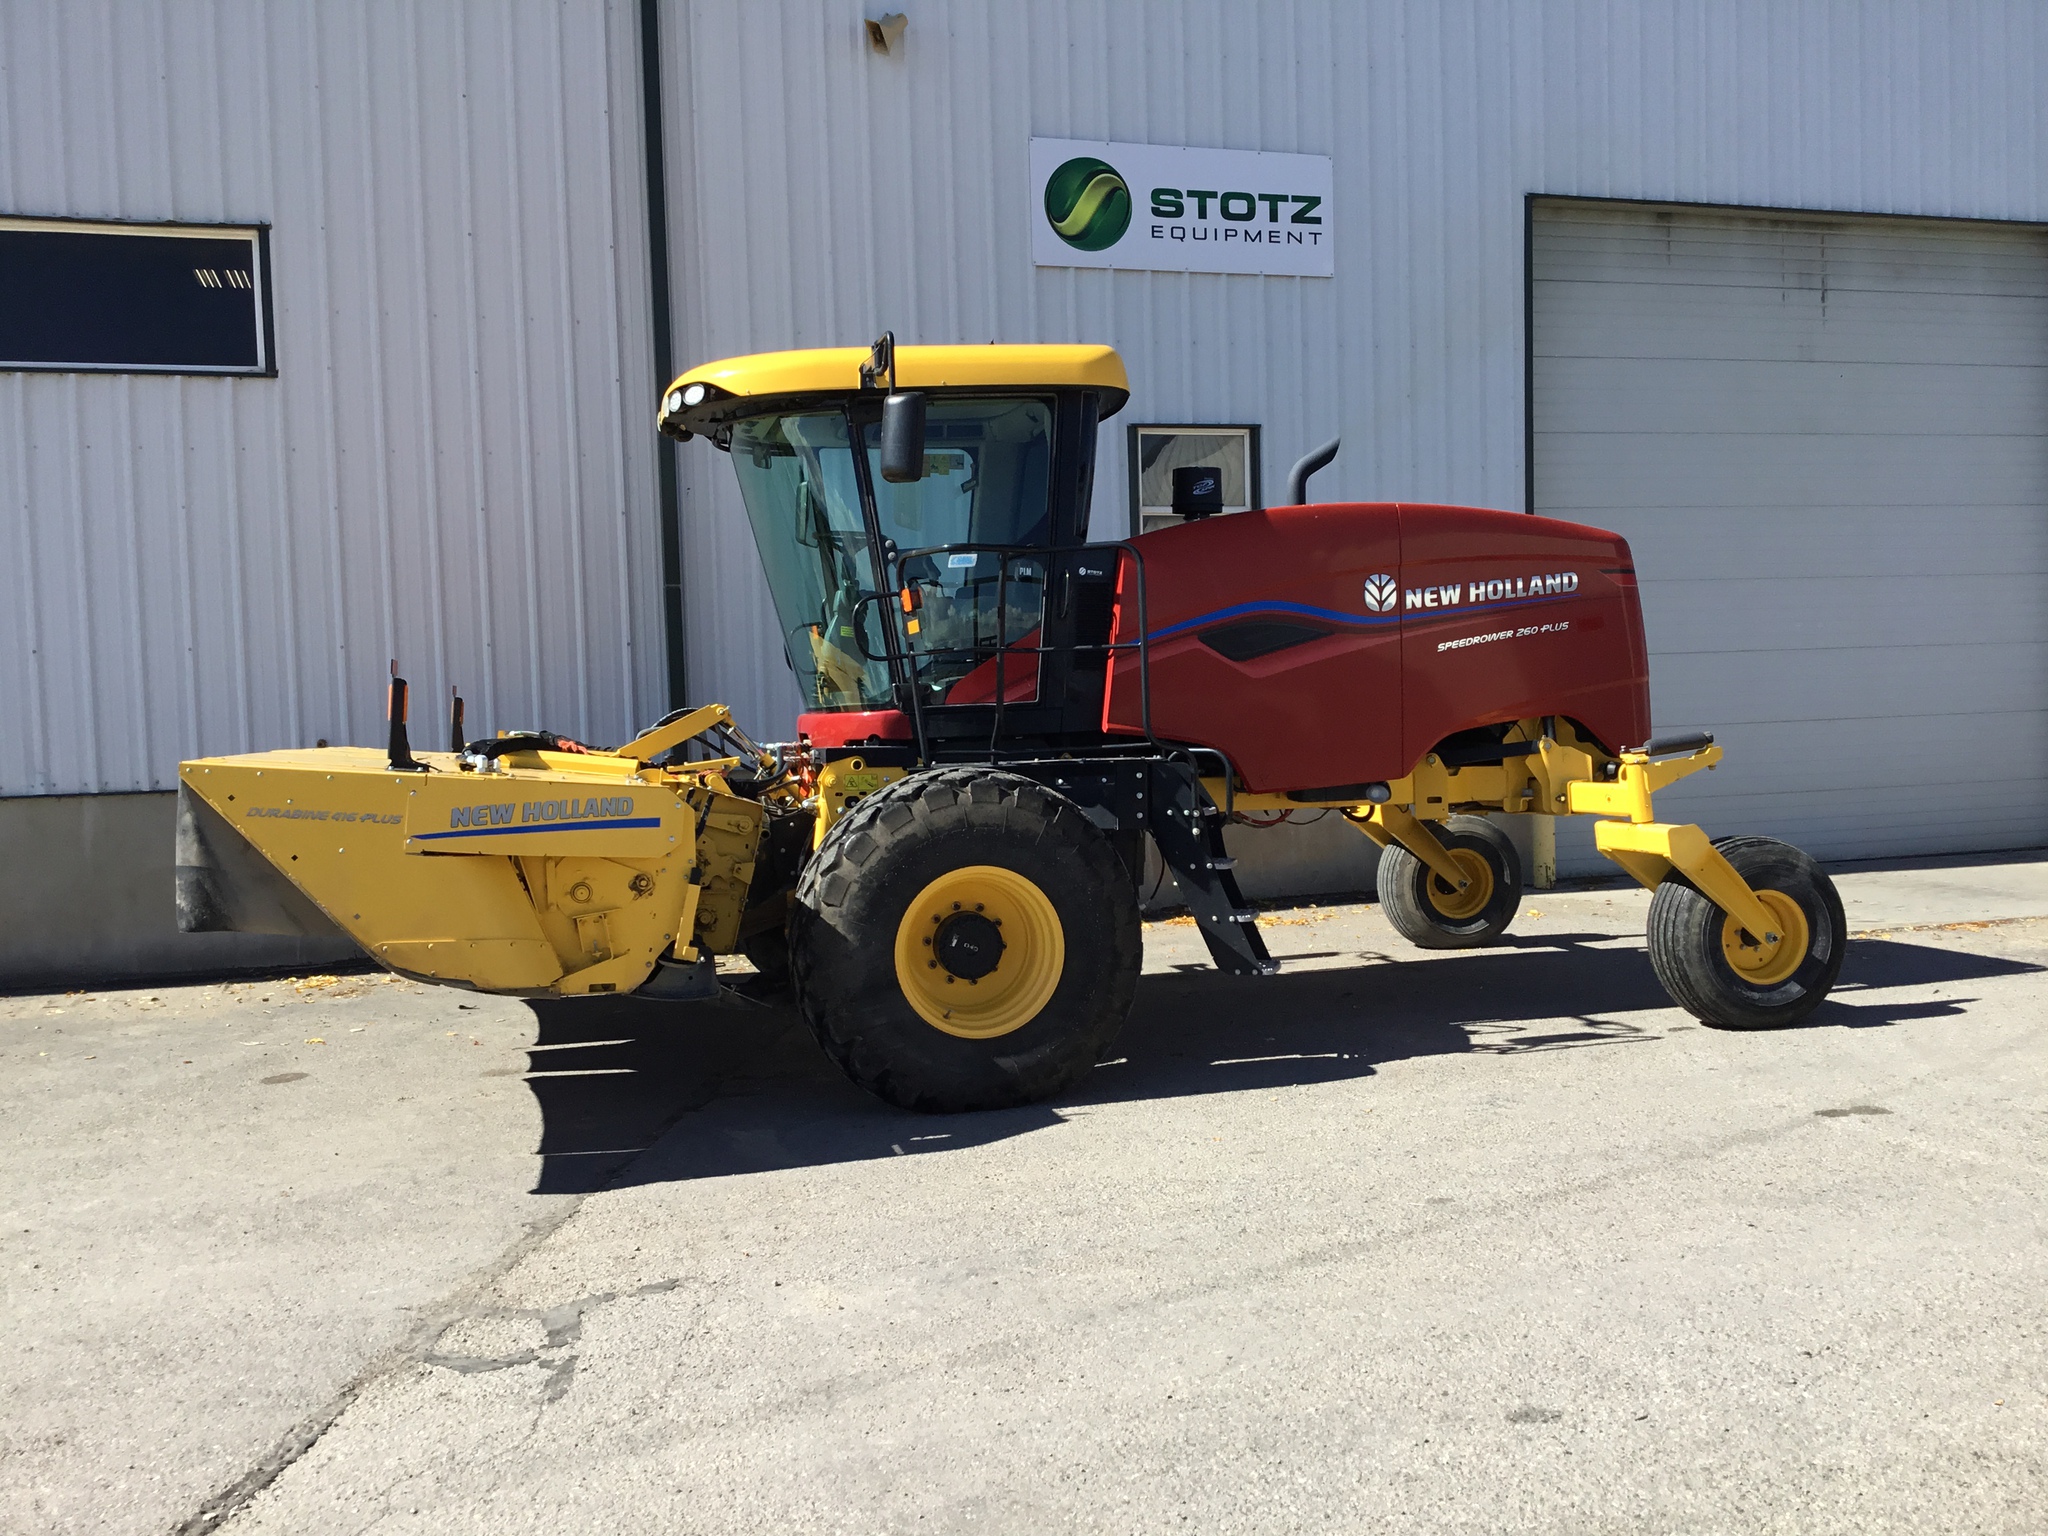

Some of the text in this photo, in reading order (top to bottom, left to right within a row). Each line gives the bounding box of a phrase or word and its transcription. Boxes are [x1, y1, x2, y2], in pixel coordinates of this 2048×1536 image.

[1150, 187, 1322, 225] STOTZ
[1151, 225, 1323, 246] EQUIPMENT
[1405, 571, 1579, 609] NEW HOLLAND
[1437, 629, 1514, 652] SPEEDROWER
[1515, 625, 1539, 638] 260
[246, 807, 330, 821] DURABINE
[331, 811, 358, 822] 416
[450, 796, 634, 828] NEW HOLLAND
